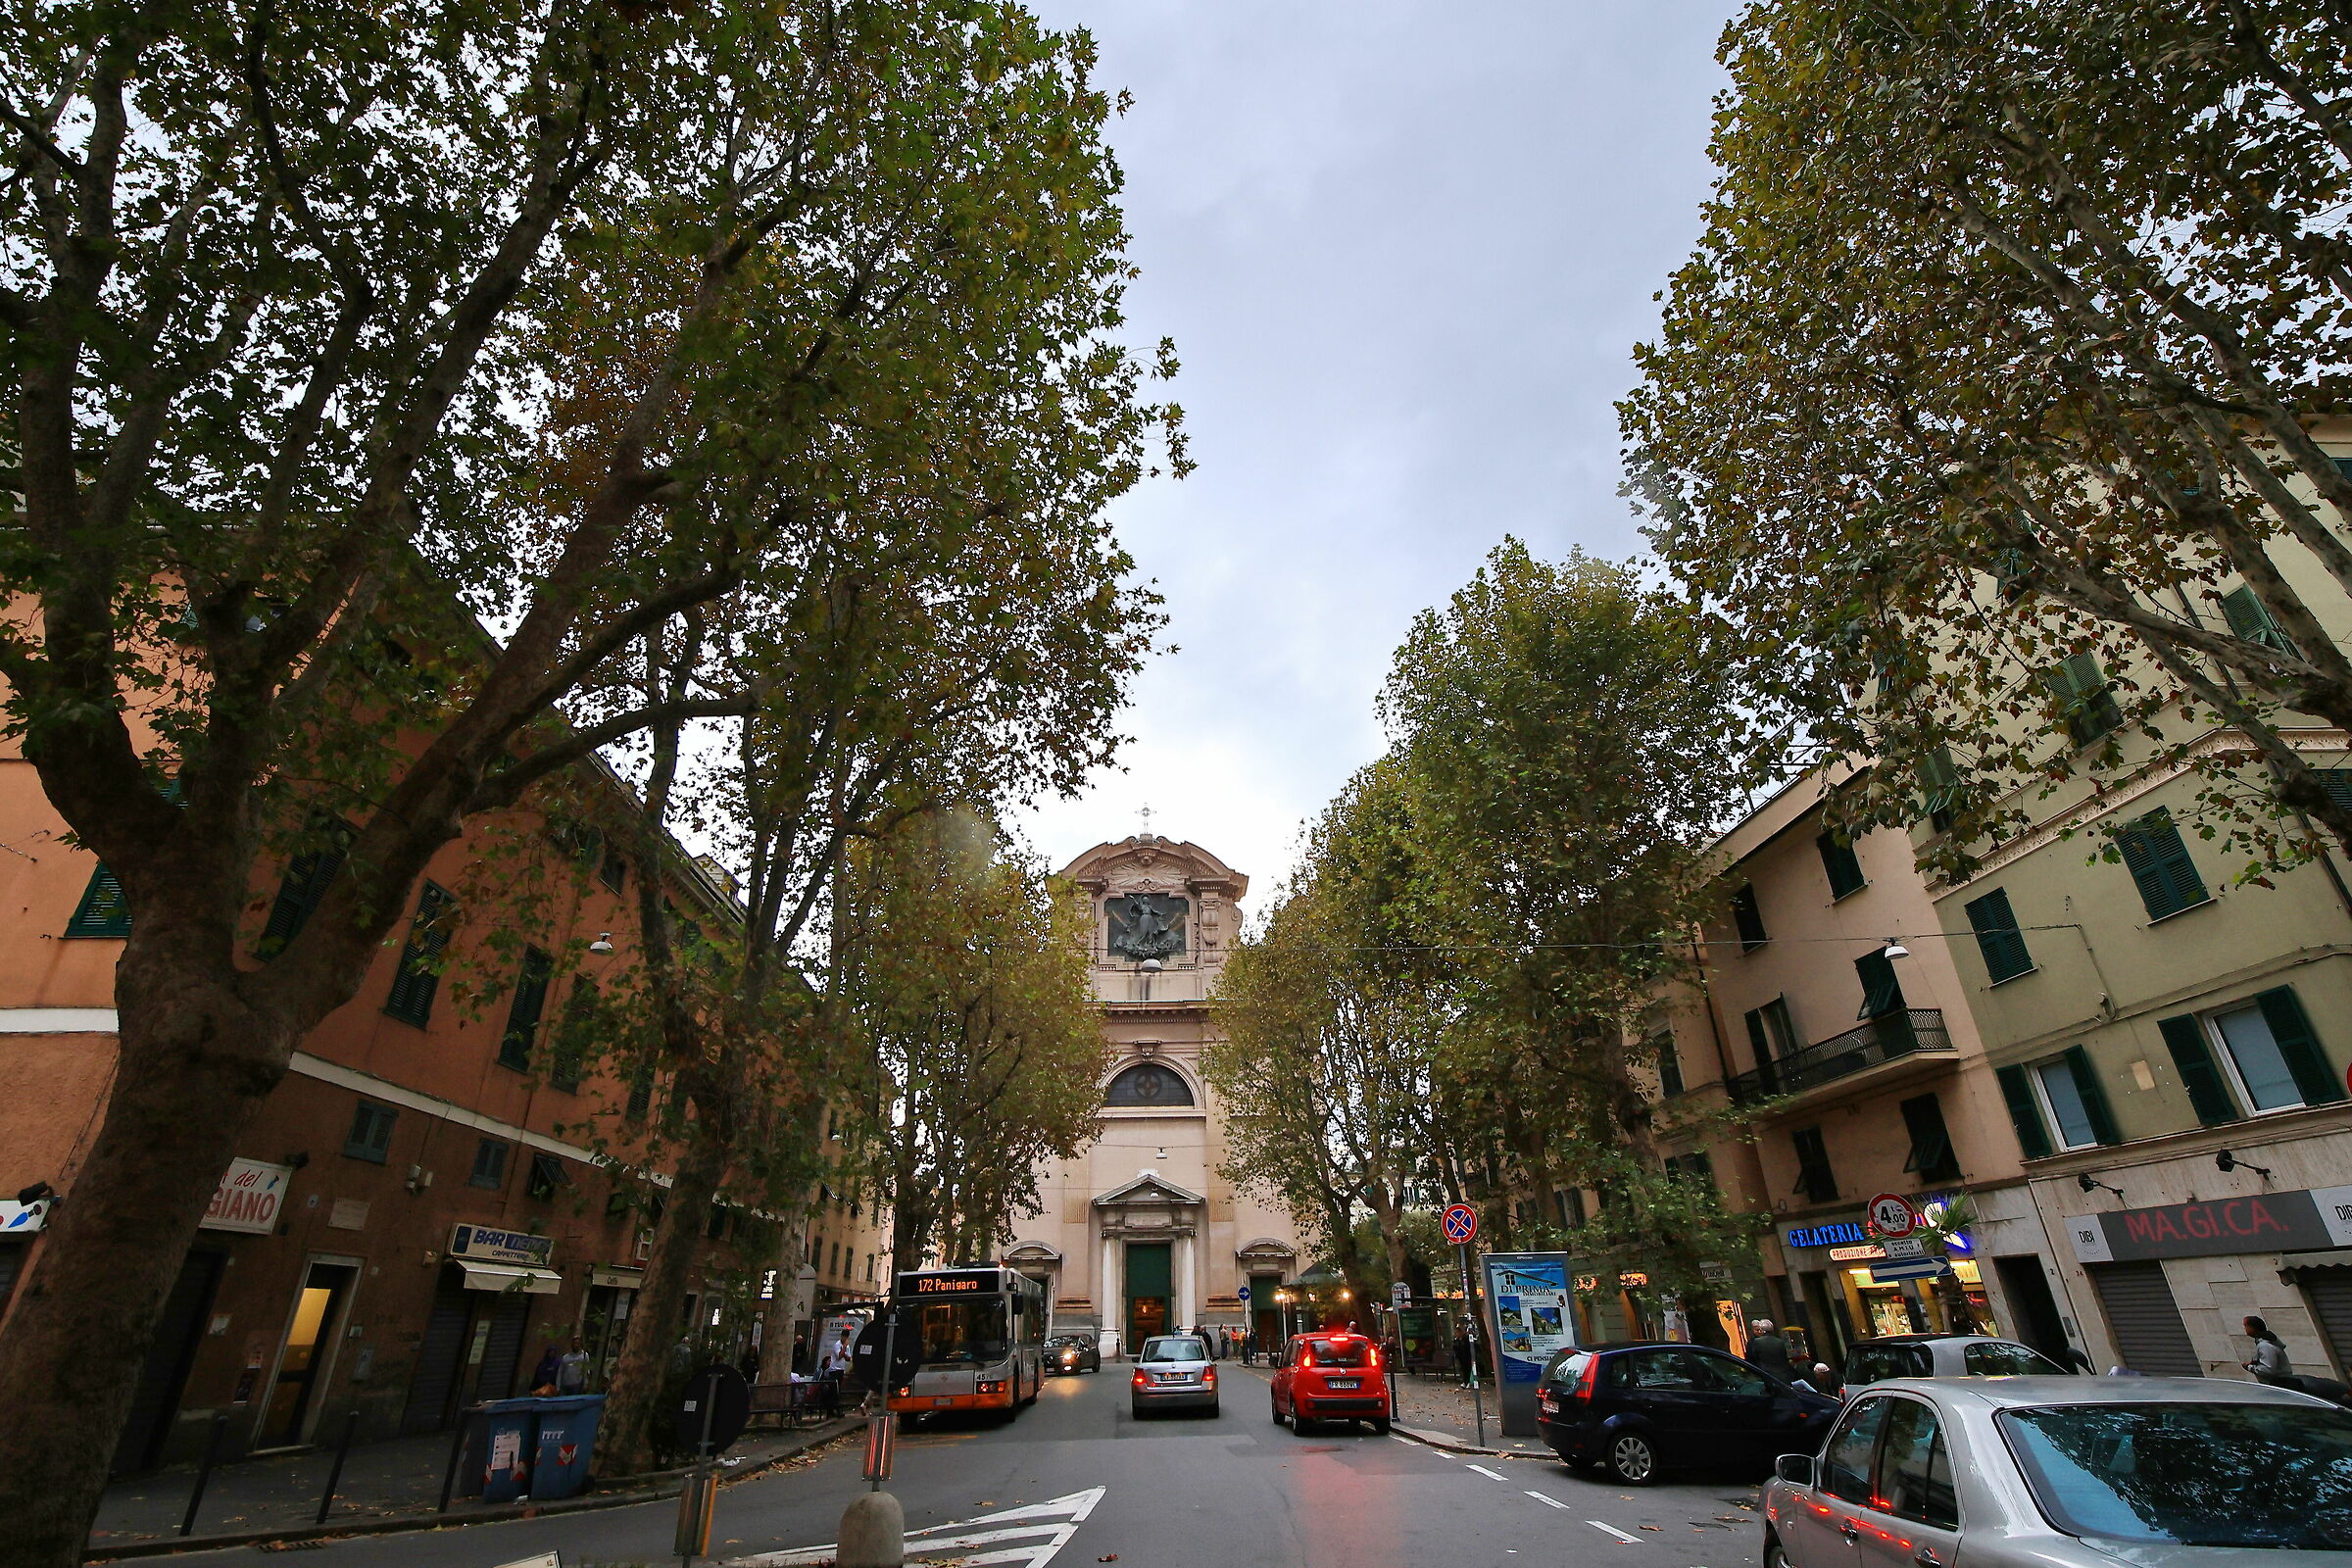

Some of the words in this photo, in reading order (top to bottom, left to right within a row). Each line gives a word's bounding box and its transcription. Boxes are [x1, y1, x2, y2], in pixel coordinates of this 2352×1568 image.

[234, 1169, 263, 1187] del
[473, 1229, 506, 1247] BAR
[1788, 1223, 1865, 1248] GELATERIA
[2078, 1230, 2095, 1244] DIBI
[918, 1279, 933, 1292] 172
[935, 1278, 977, 1292] Panigaro
[1515, 1285, 1550, 1294] PRIMA
